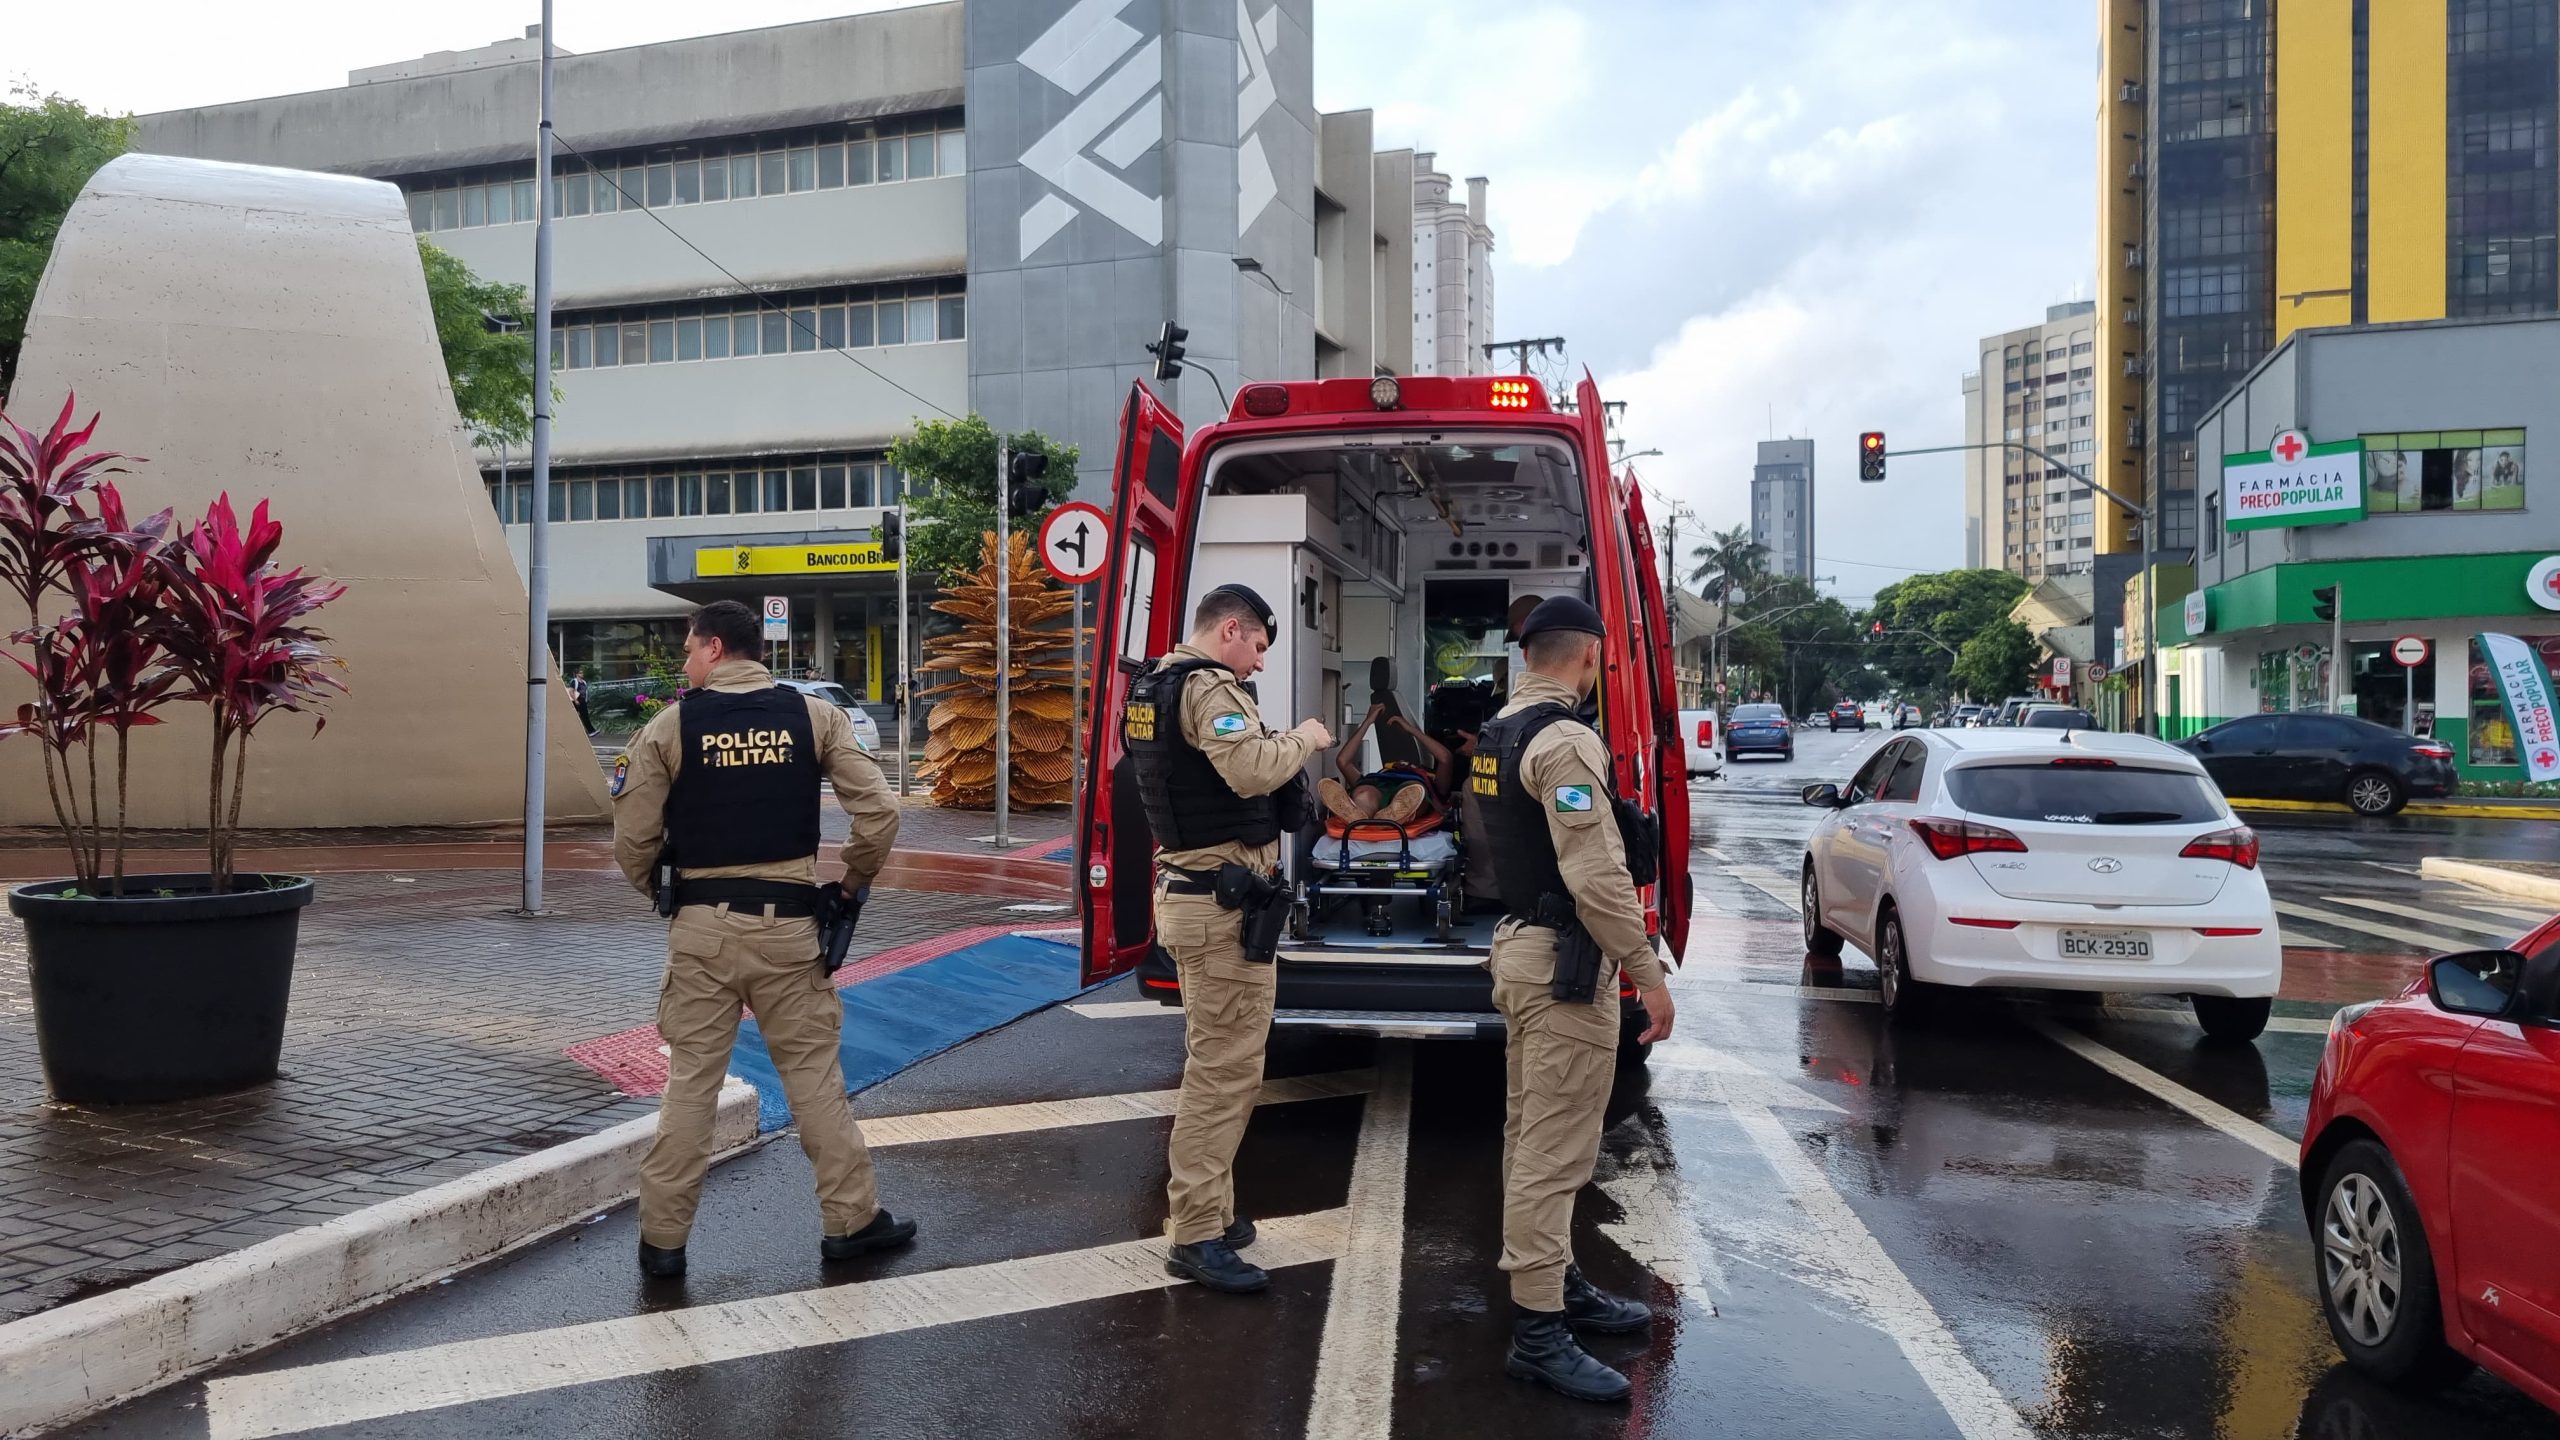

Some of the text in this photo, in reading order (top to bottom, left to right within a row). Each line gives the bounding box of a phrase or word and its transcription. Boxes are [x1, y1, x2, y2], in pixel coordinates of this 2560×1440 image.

[2240, 472, 2343, 493] FARMÁCIA
[2240, 486, 2344, 510] PREÇOPOPULAR
[807, 552, 848, 566] BANCO
[850, 553, 866, 565] DO
[772, 602, 780, 614] E
[2092, 668, 2104, 677] 40
[2503, 662, 2539, 745] FARMÁCIA
[702, 728, 794, 751] POLÍCIA
[1126, 721, 1154, 740] MILITAR
[1471, 752, 1498, 776] POLÍCIA
[1471, 776, 1499, 797] MILITAR
